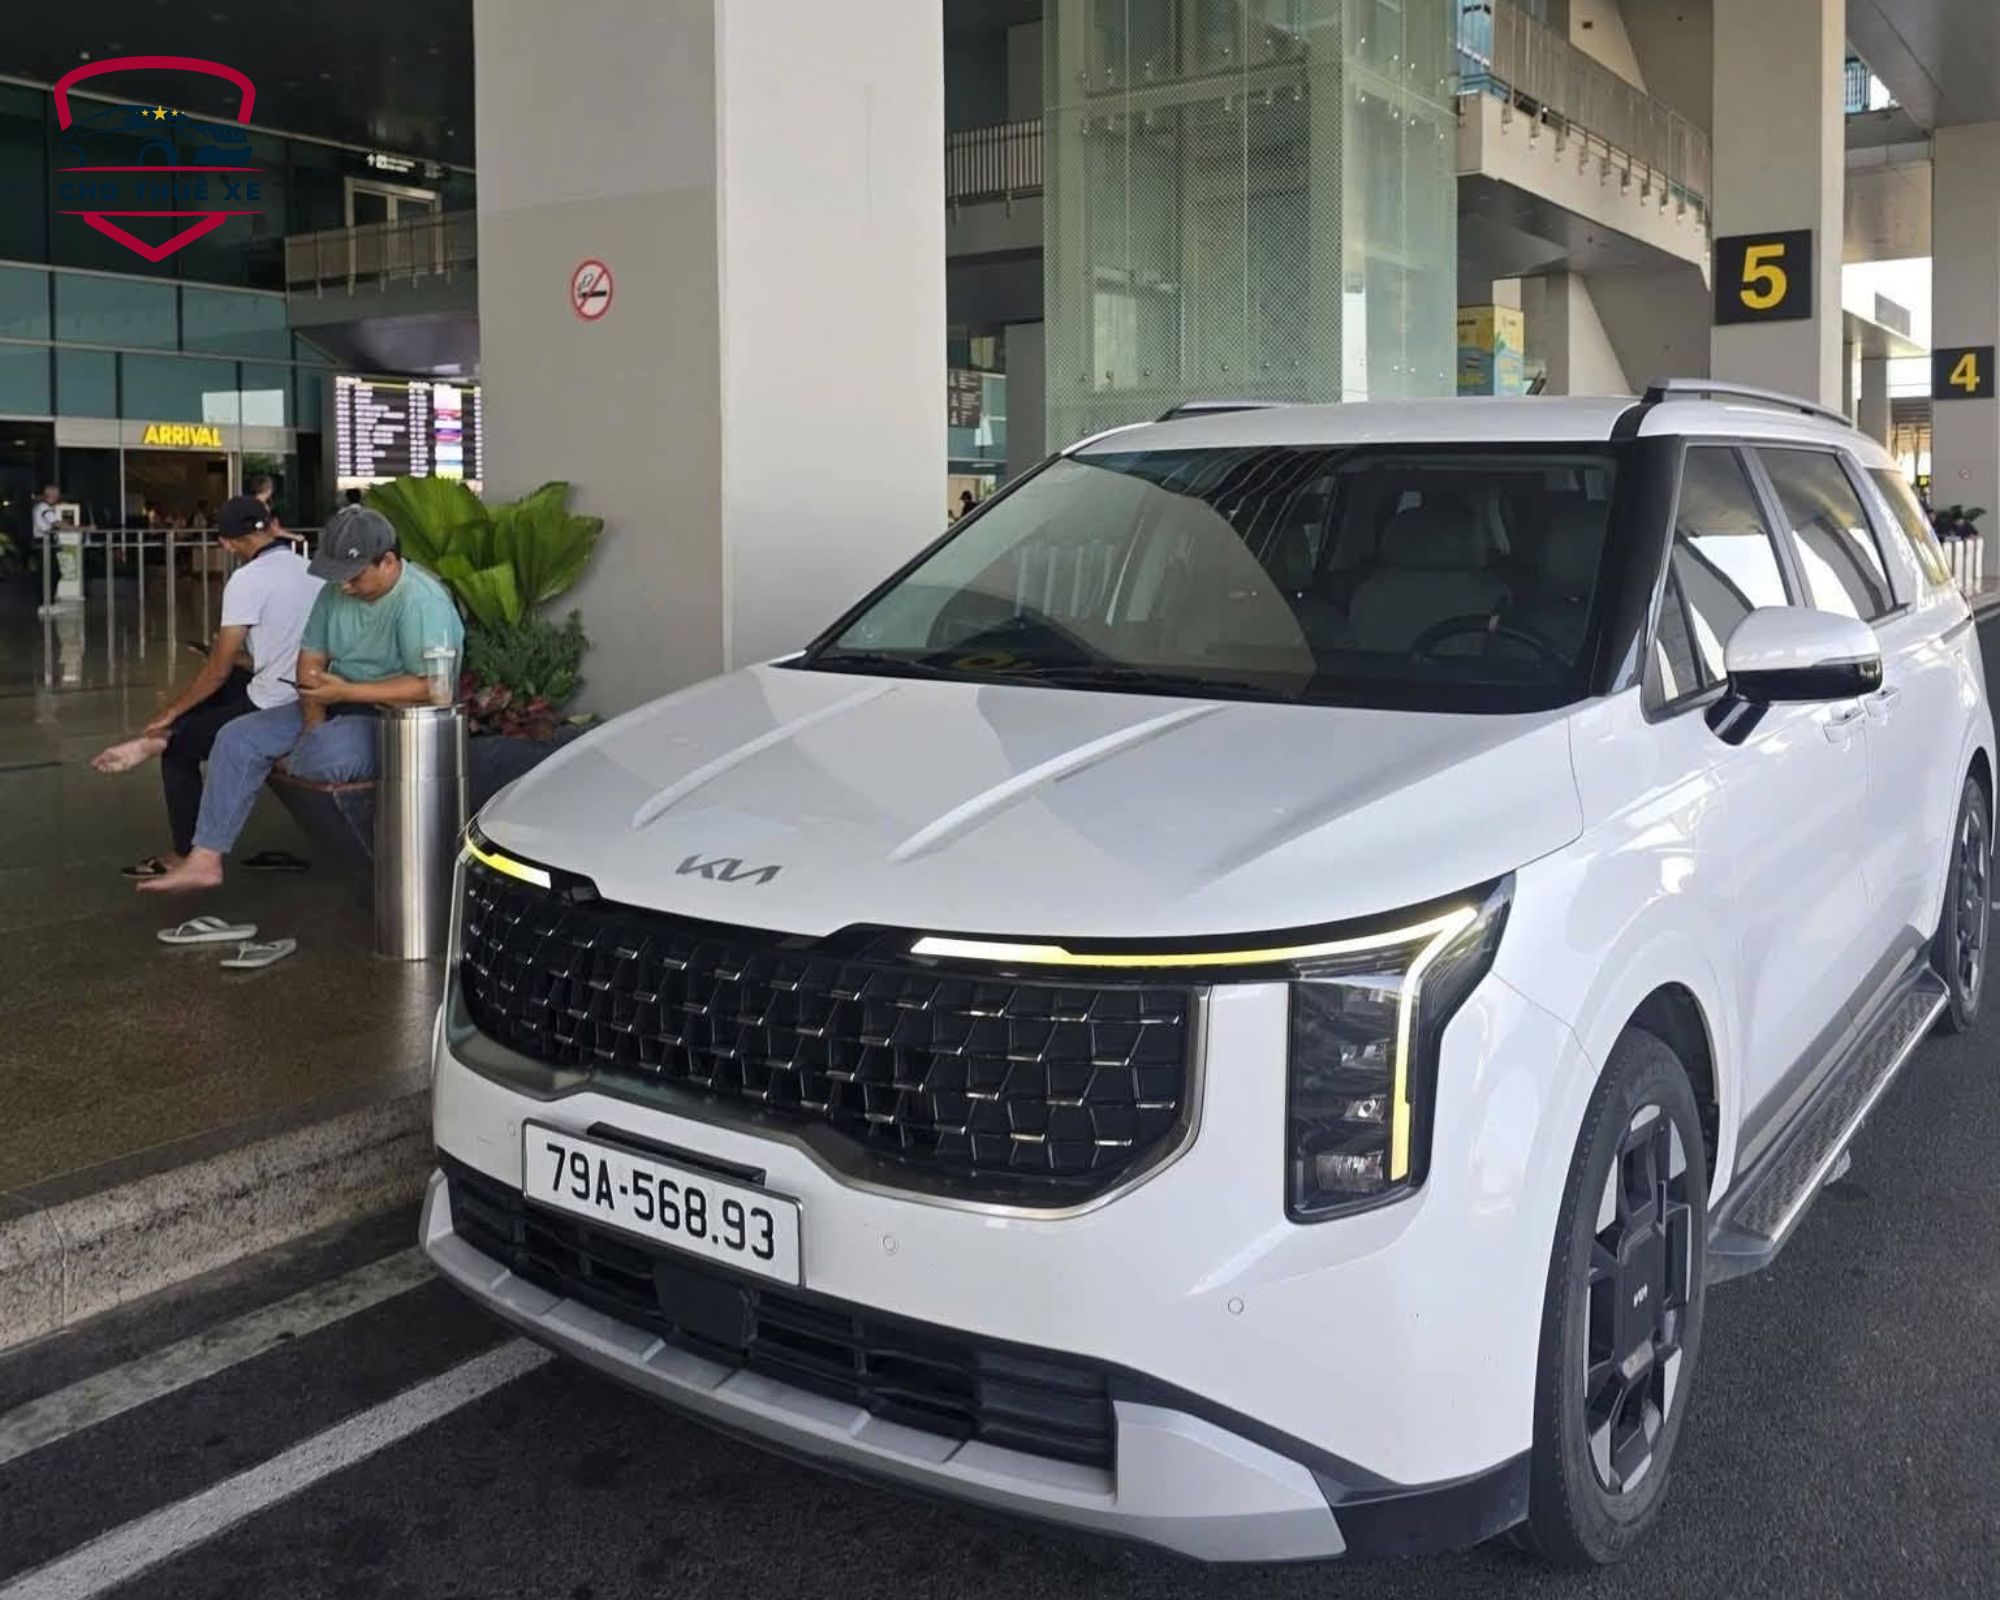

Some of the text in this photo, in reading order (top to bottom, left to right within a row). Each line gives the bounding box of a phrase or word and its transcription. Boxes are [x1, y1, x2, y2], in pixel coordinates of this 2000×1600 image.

[1740, 243, 1787, 309] 5
[1949, 353, 1980, 393] 4
[144, 424, 222, 446] ARRIVAL
[547, 1143, 775, 1261] 79A-568.93
